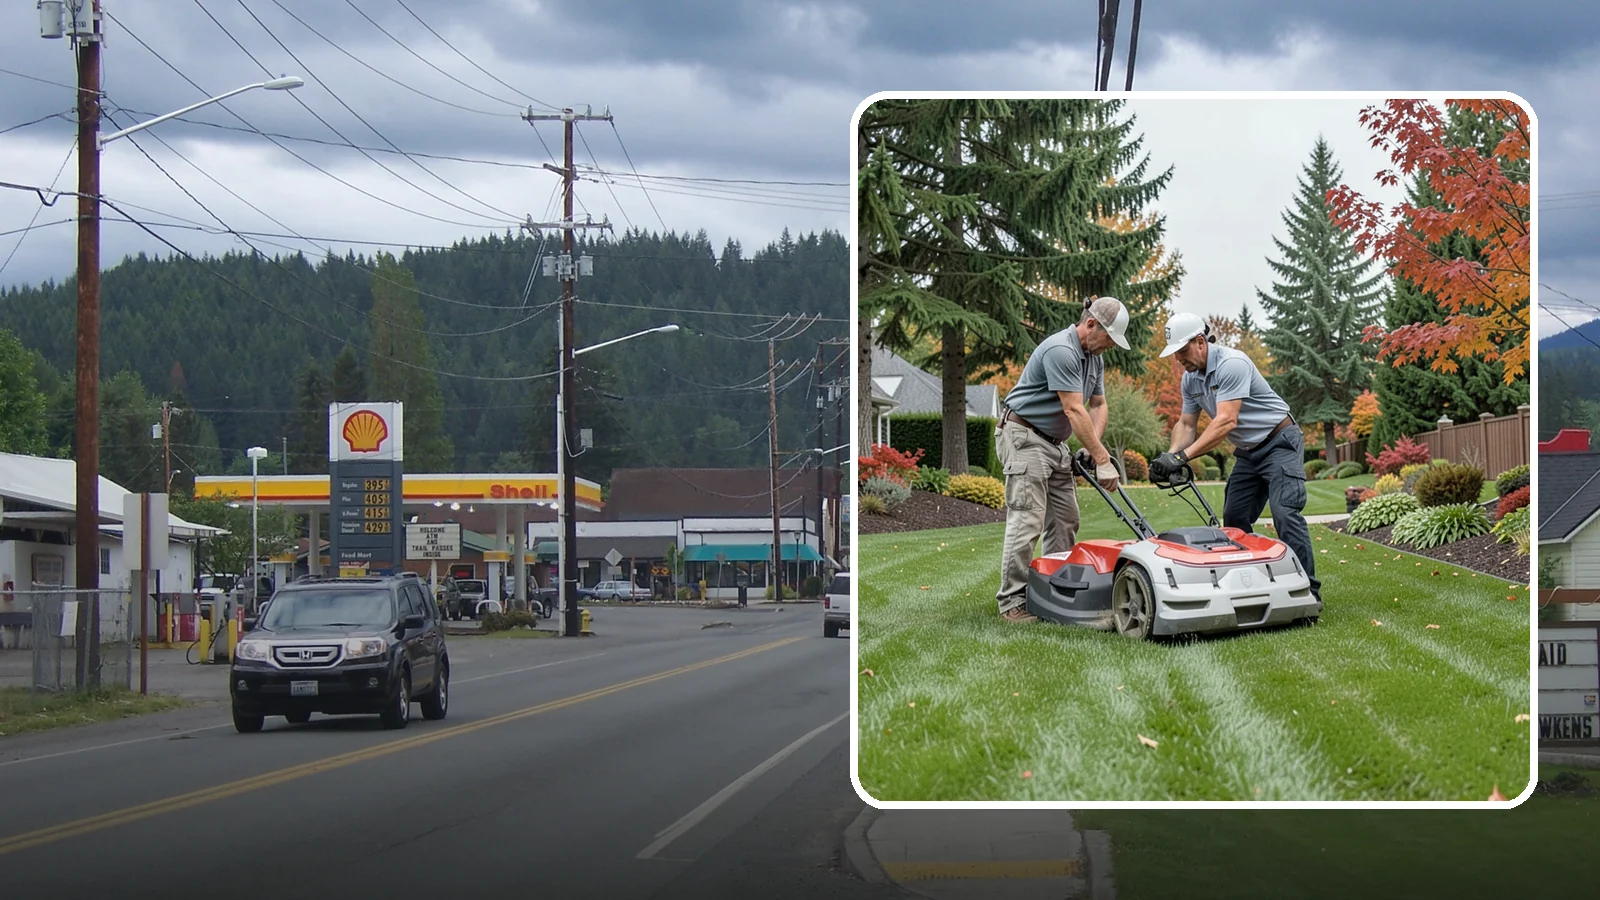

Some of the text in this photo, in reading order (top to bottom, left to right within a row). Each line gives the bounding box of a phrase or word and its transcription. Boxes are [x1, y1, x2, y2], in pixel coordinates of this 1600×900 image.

[366, 480, 383, 490] 395
[490, 484, 547, 498] Shell
[366, 494, 383, 504] 405
[366, 508, 383, 518] 415
[366, 522, 383, 533] 429
